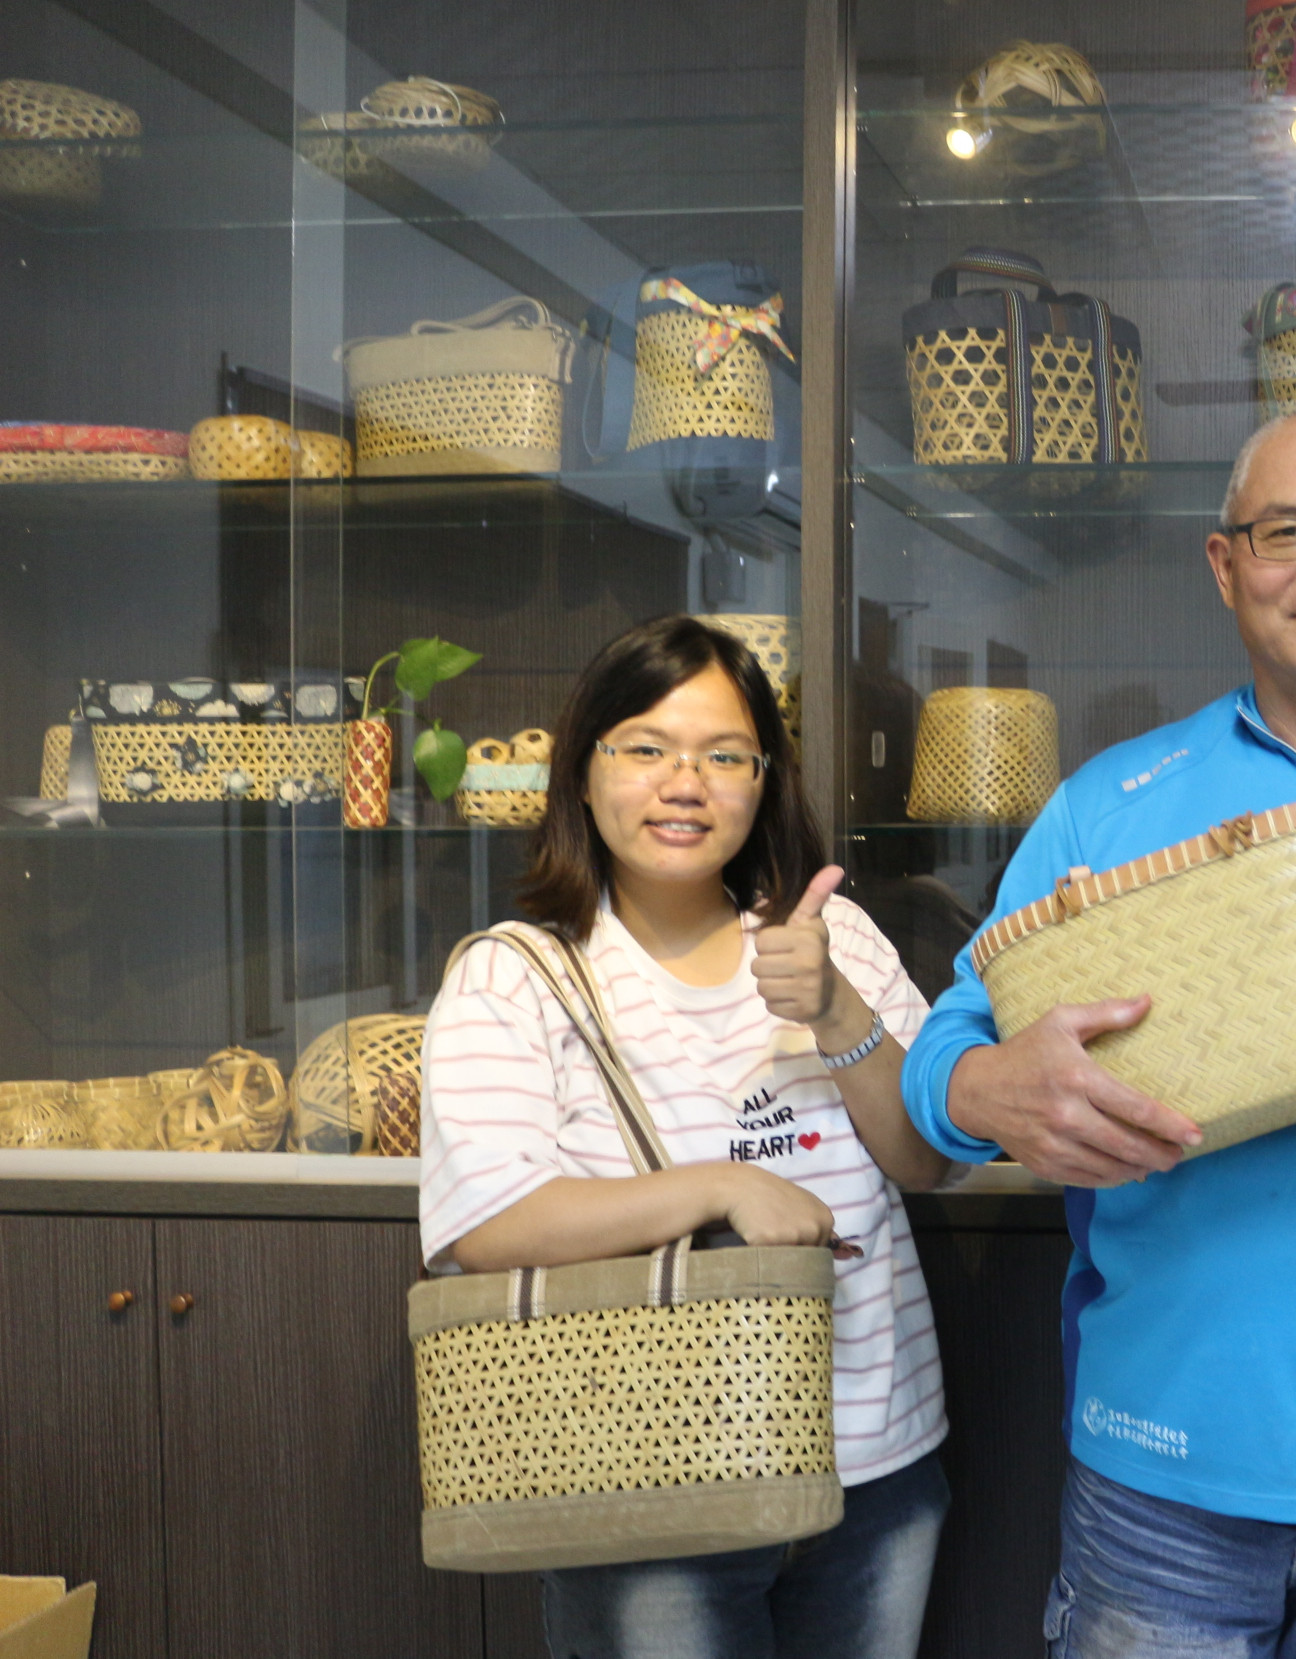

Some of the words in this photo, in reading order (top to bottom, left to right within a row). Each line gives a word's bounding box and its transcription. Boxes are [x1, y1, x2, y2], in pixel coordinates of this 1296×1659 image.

[743, 1087, 778, 1115] ALL
[735, 1106, 796, 1131] YOUR
[729, 1133, 796, 1162] HEART
